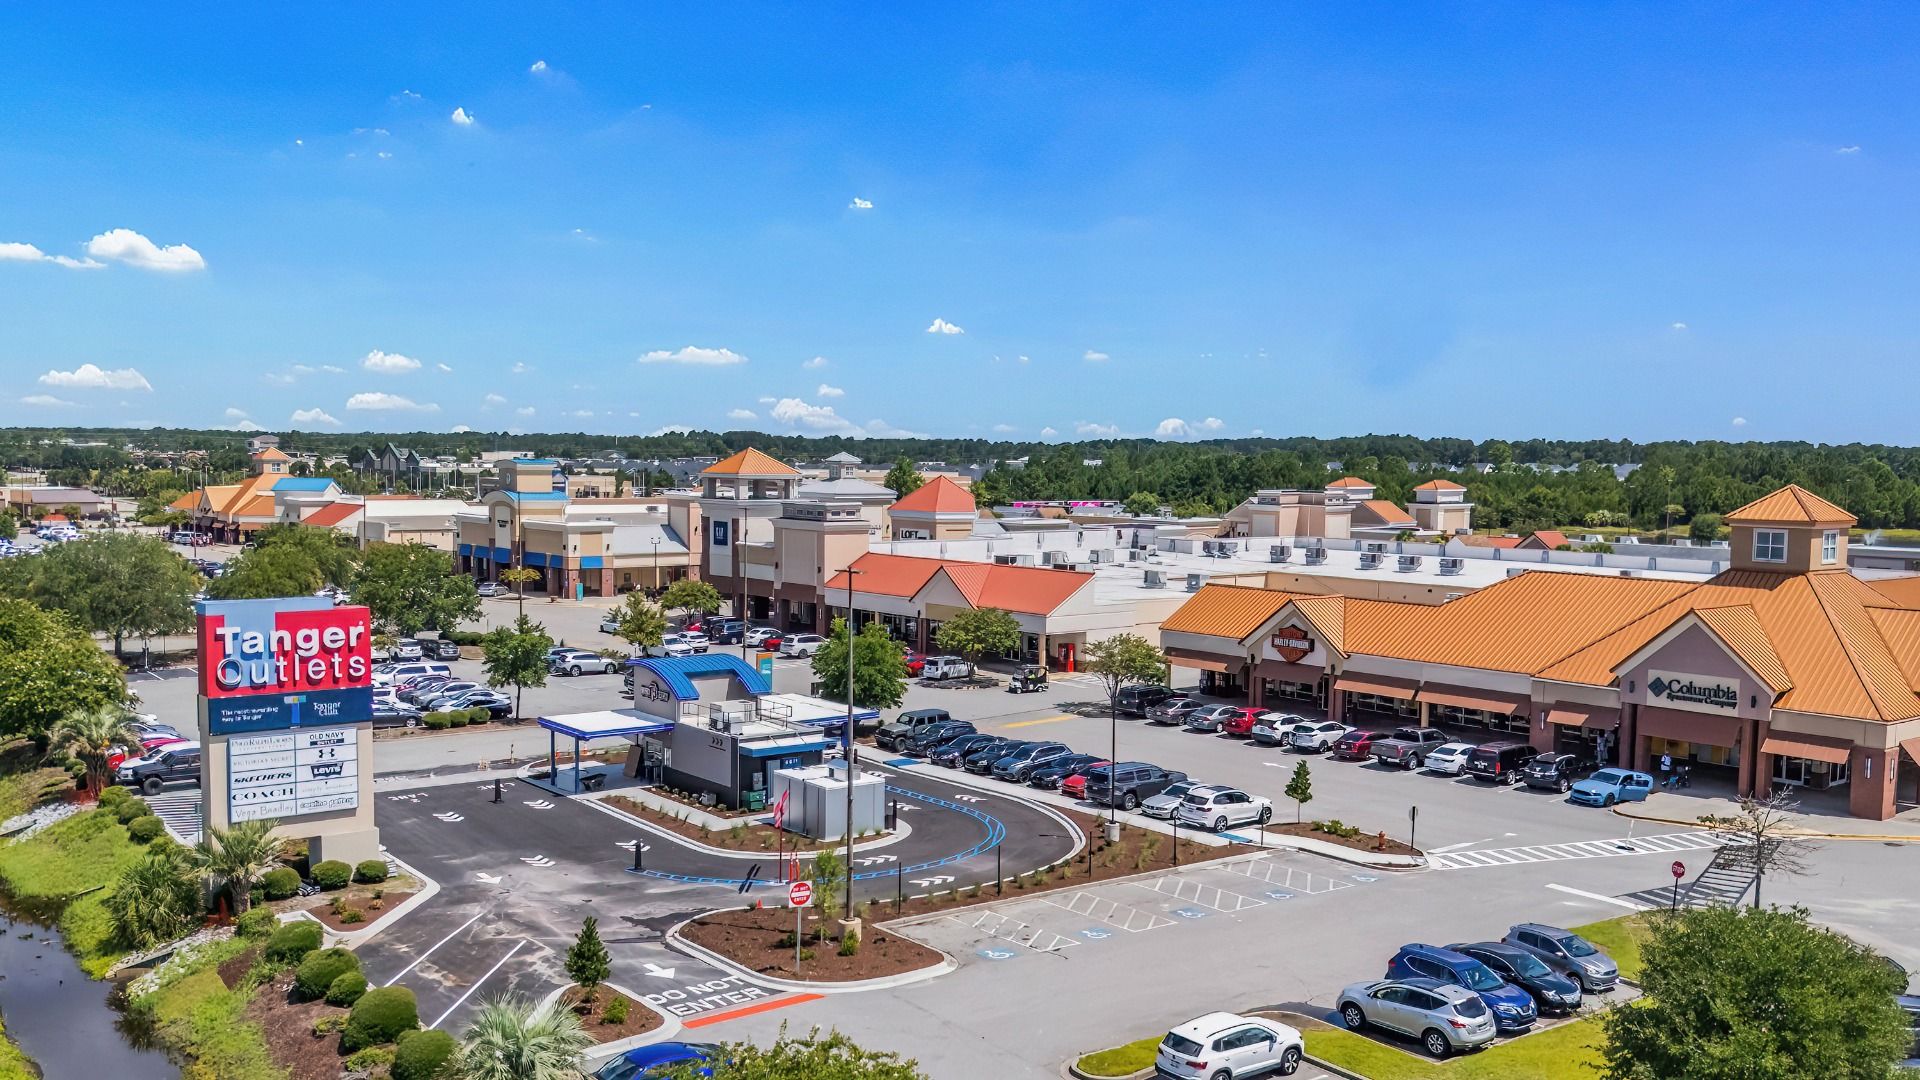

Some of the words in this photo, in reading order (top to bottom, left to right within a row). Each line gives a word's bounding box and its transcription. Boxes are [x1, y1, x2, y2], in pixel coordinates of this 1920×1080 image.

[901, 530, 919, 539] LOFT
[216, 624, 364, 657] Tanger
[217, 652, 366, 686] Outlets
[1667, 679, 1738, 701] Columbia
[325, 731, 345, 739] NAVY
[233, 772, 293, 783] SKECHERS
[232, 787, 294, 801] COACH
[643, 989, 688, 1006] DO
[685, 975, 744, 995] NOT
[666, 987, 770, 1016] ENTER
